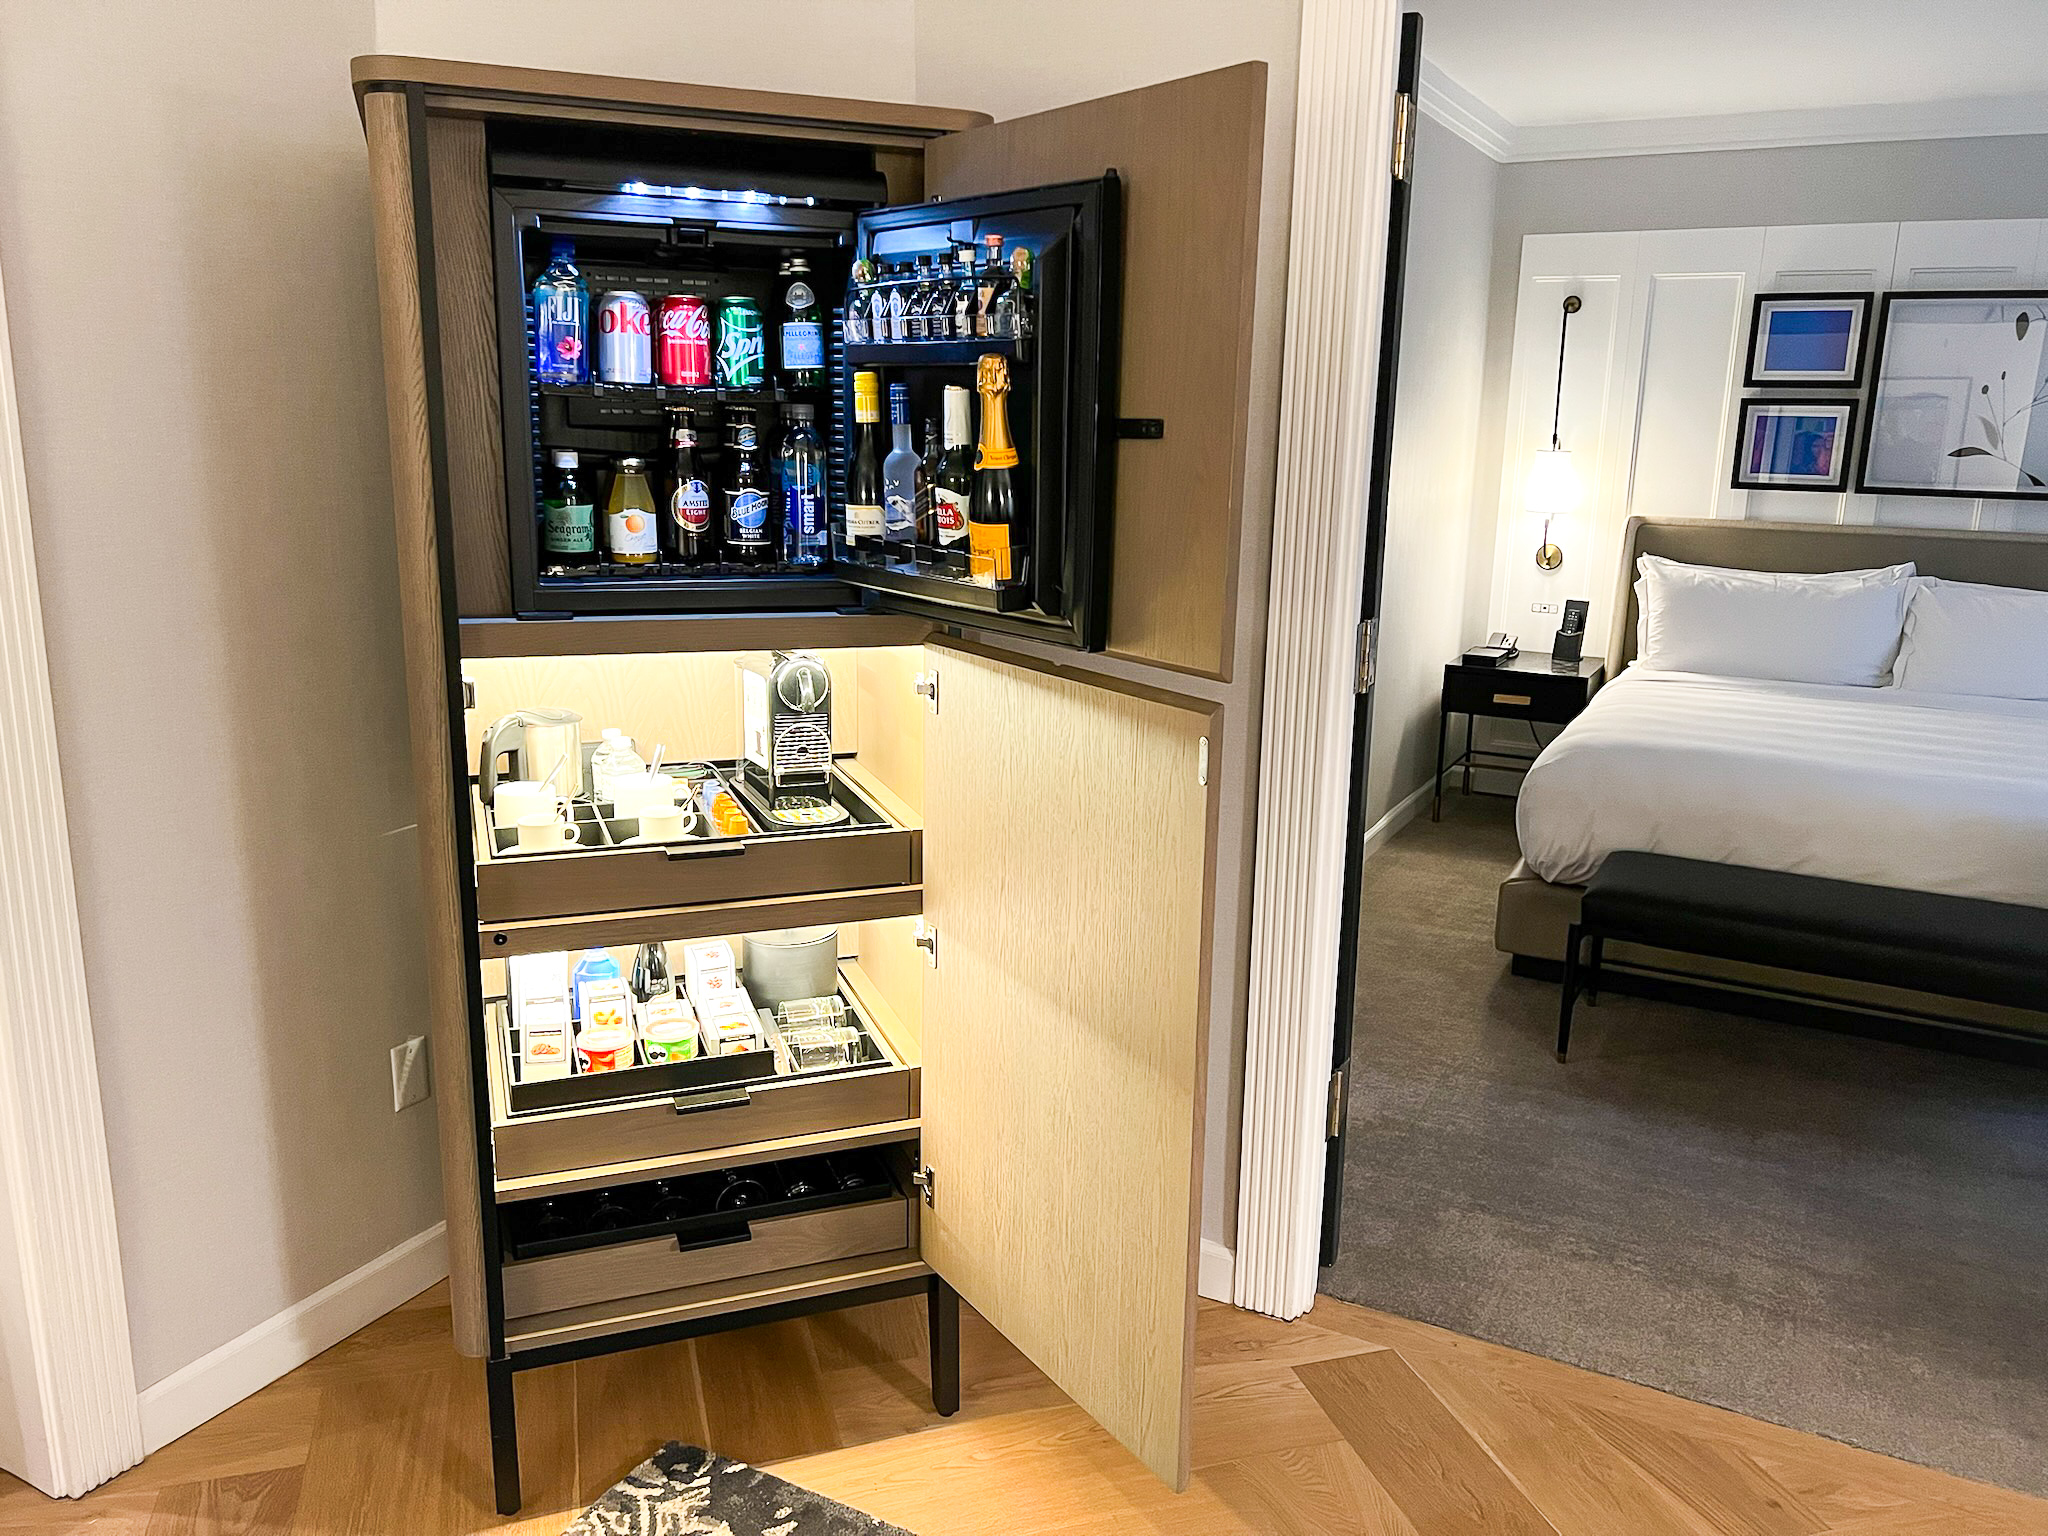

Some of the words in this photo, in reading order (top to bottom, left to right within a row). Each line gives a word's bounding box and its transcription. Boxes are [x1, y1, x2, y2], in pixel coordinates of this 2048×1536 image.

[547, 295, 580, 322] FIJI
[732, 506, 750, 519] BLUE
[801, 493, 815, 535] smart
